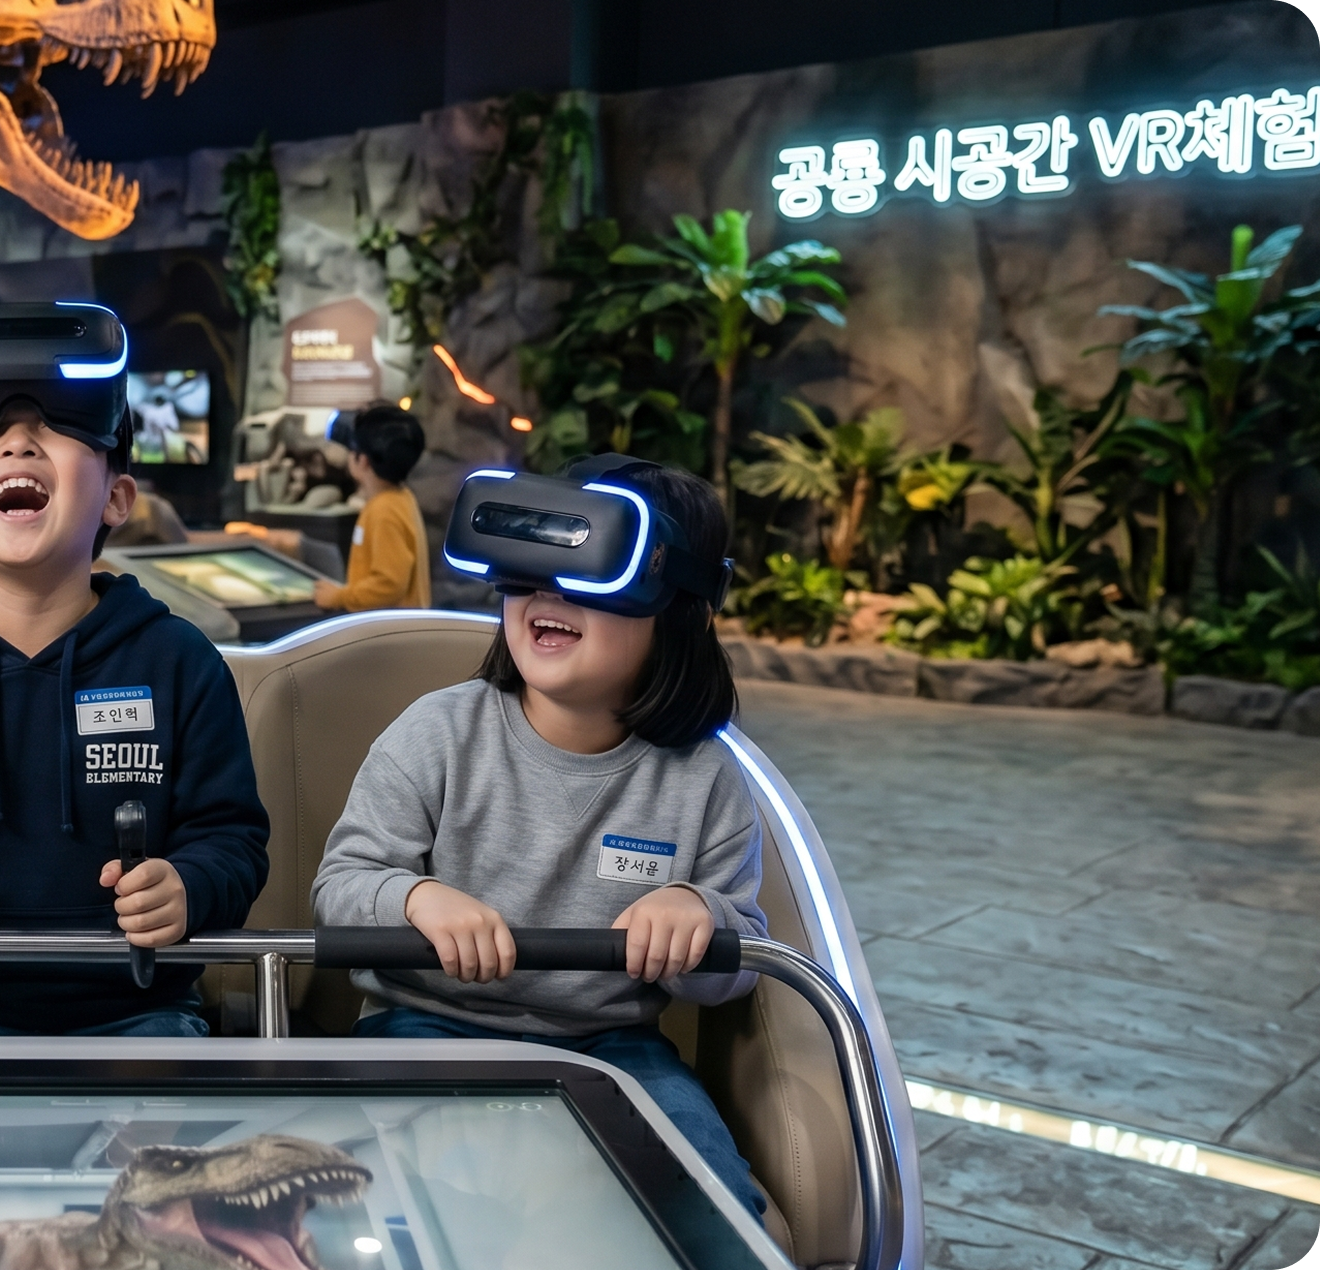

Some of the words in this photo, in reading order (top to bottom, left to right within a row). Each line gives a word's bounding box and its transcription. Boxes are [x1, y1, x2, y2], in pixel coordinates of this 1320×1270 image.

[771, 138, 886, 218] 공룡
[893, 115, 1079, 203] 시공간
[1088, 85, 1320, 178] VR체험
[85, 743, 163, 770] SEOUL
